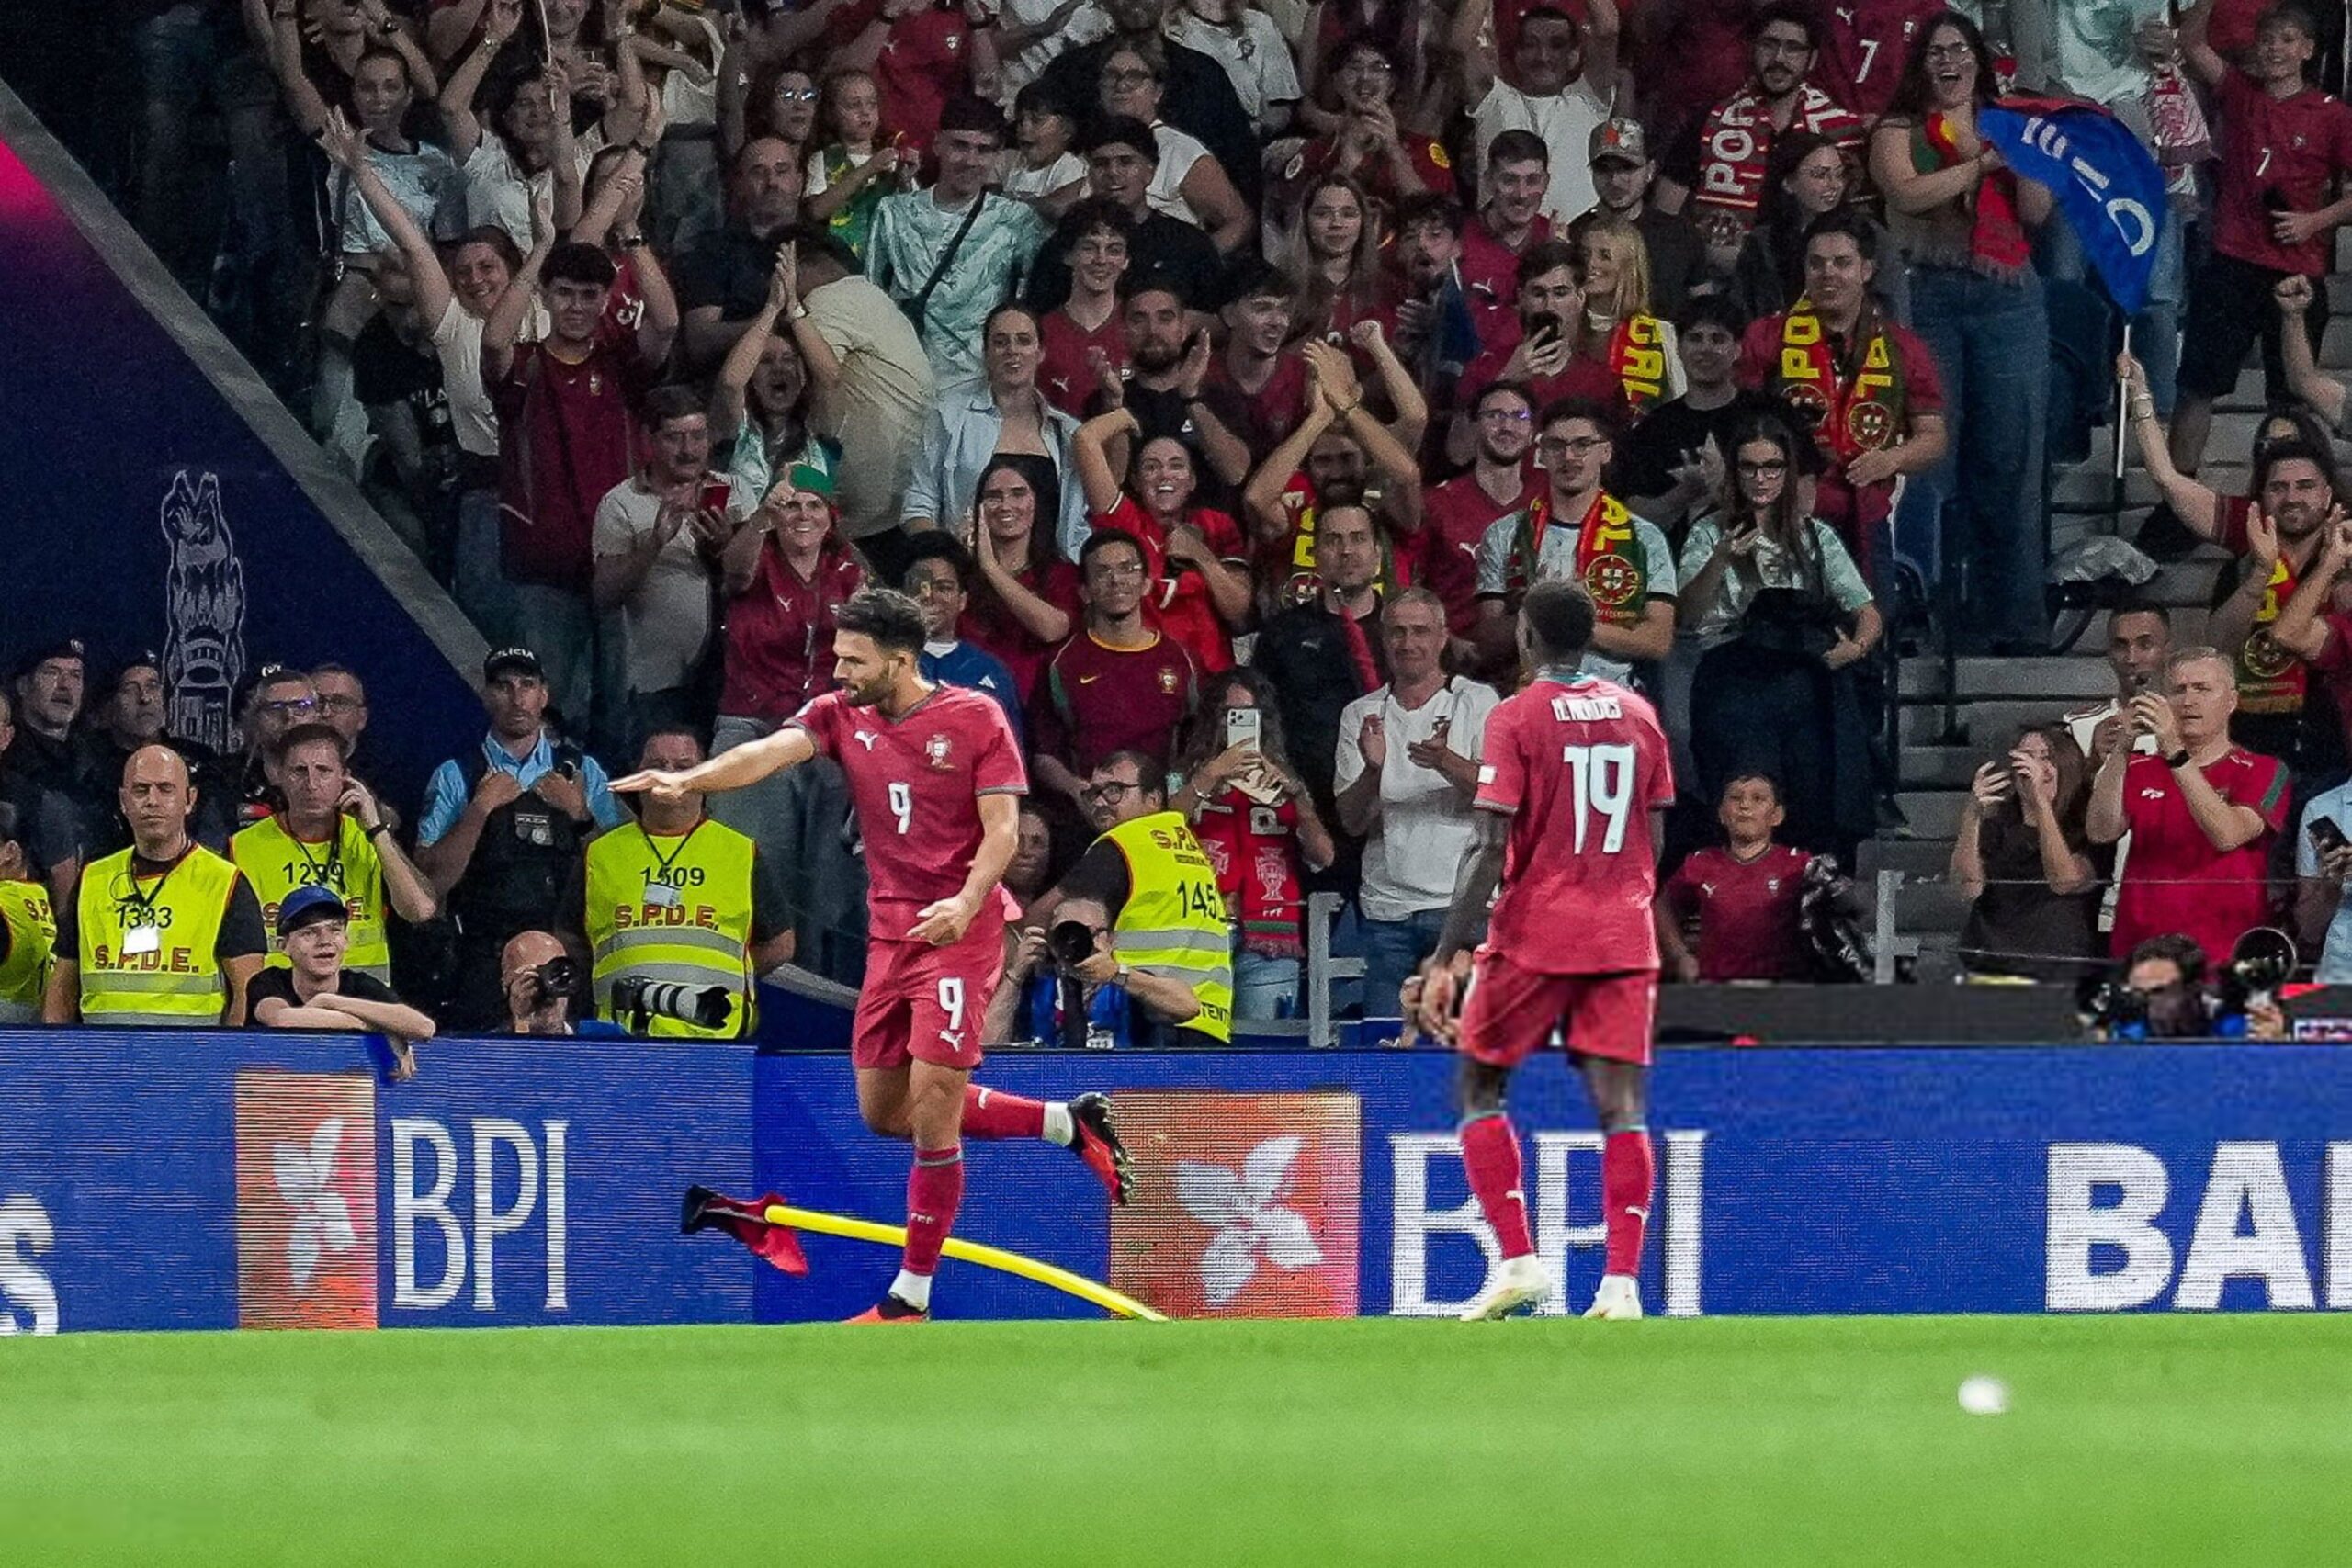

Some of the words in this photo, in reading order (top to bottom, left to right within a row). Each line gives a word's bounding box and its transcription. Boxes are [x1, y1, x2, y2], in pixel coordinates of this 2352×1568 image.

[1856, 39, 1880, 83] 7
[2256, 148, 2270, 176] 7
[1159, 579, 1176, 610] 7
[888, 782, 910, 834] 9
[1564, 745, 1634, 855] 19
[938, 976, 965, 1031] 9
[391, 1117, 568, 1312] BPI
[2045, 1140, 2352, 1311] BA
